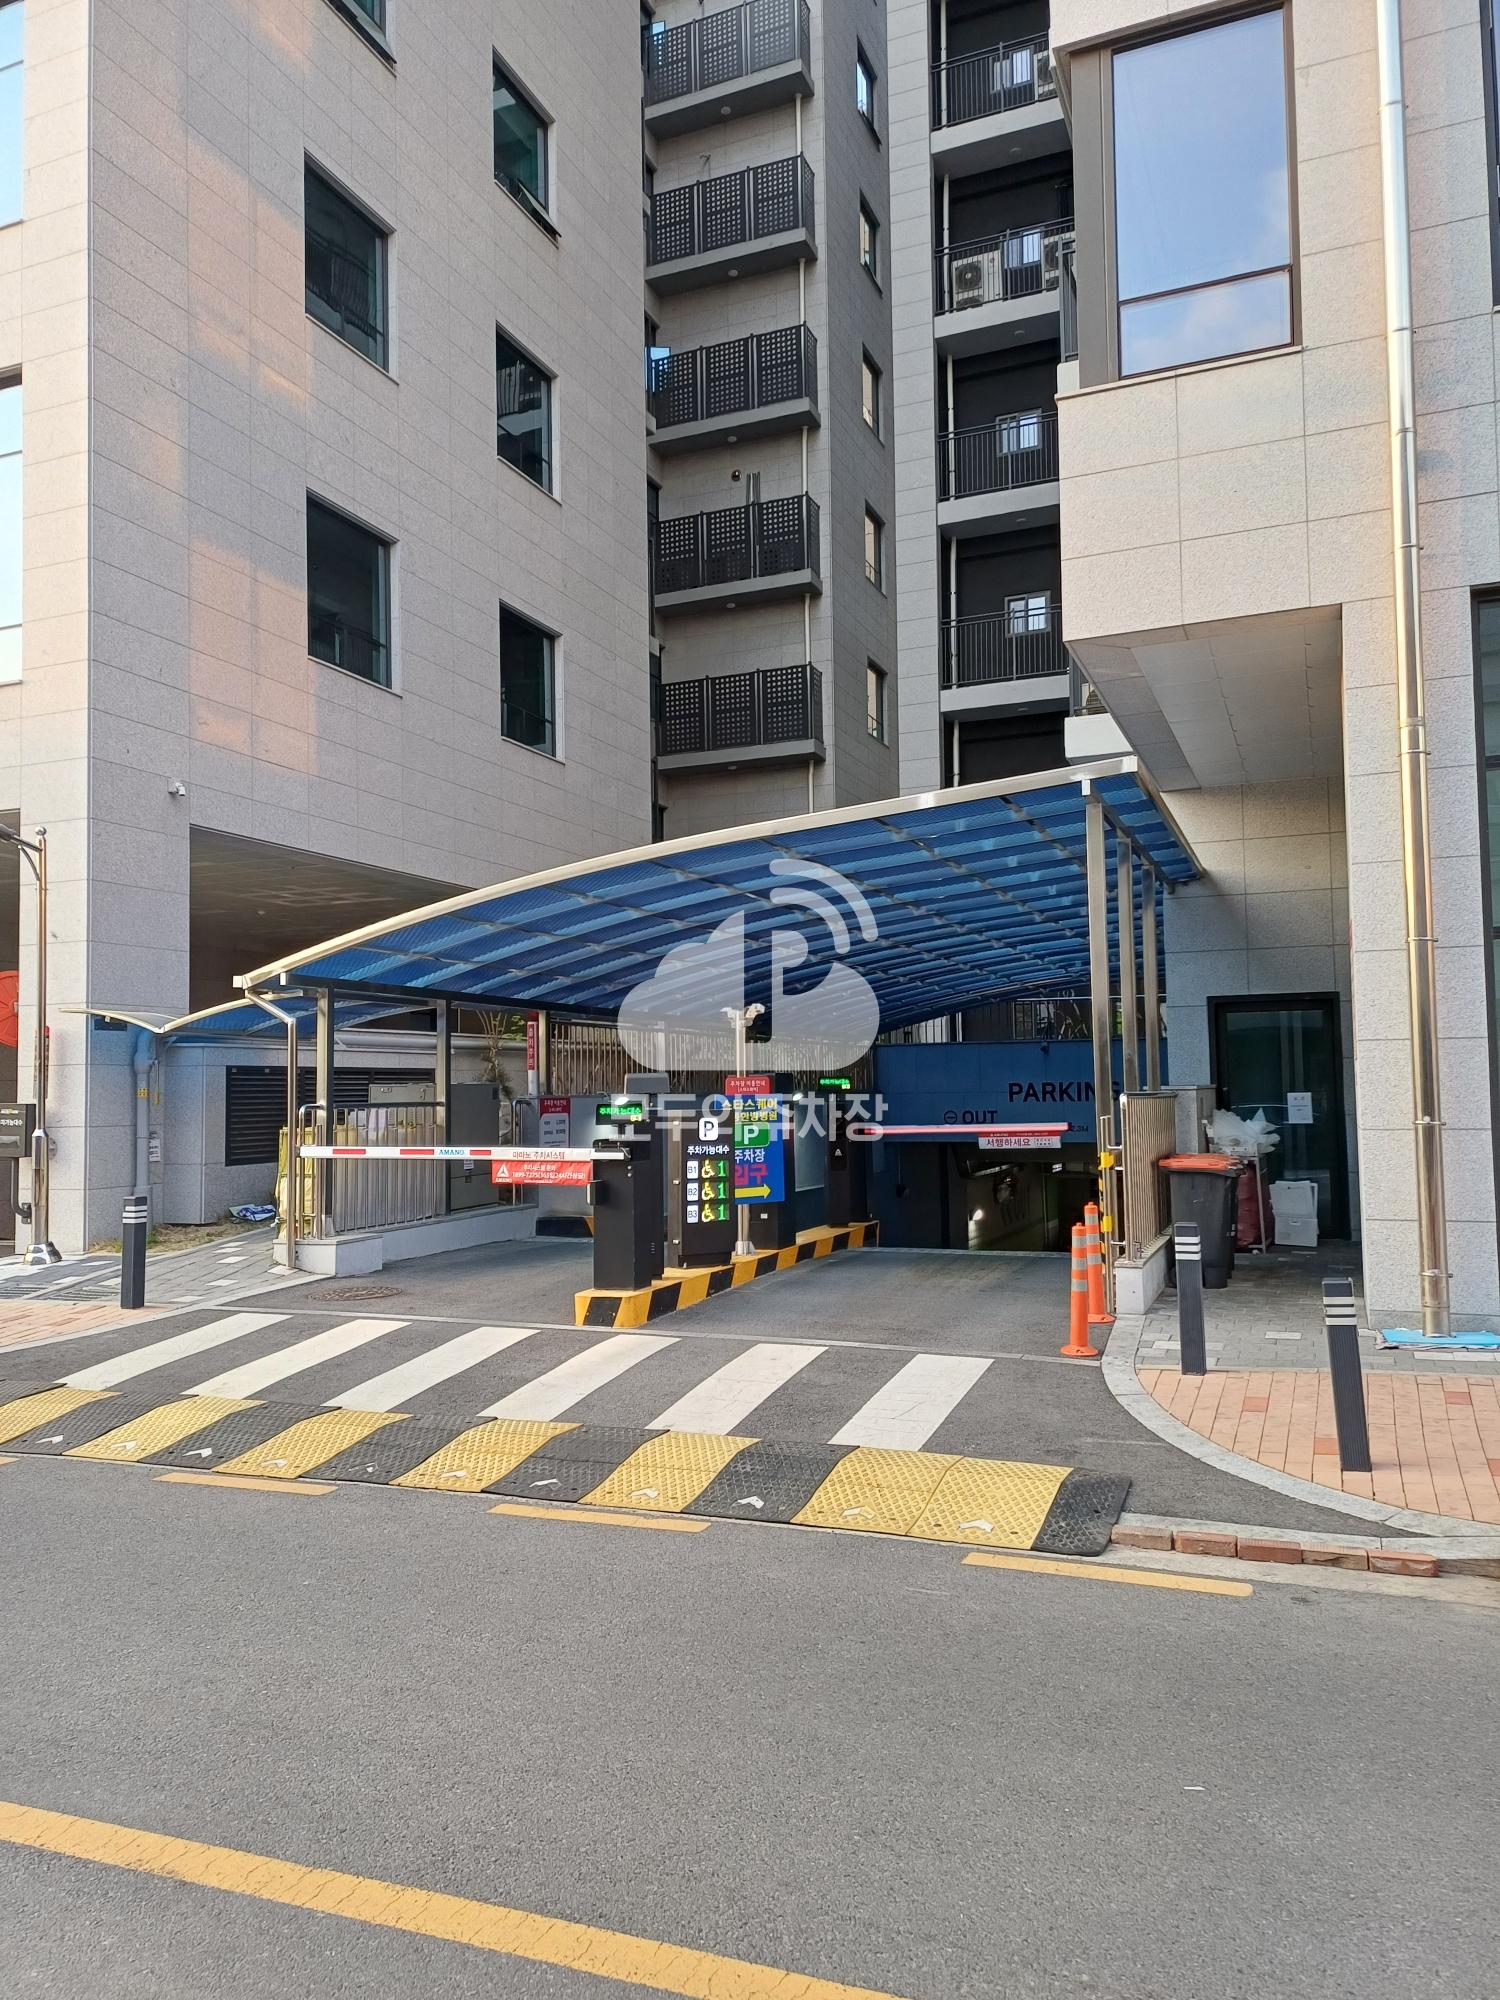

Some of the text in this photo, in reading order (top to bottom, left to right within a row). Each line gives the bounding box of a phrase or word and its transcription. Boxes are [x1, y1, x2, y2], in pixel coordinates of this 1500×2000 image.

[962, 1110, 998, 1124] OUT
[704, 1121, 715, 1138] P
[743, 1124, 760, 1145] P
[986, 1138, 1031, 1148] 서행하세요
[687, 1145, 730, 1155] 주차가능대수
[735, 1148, 766, 1163] 주차장
[688, 1187, 697, 1196] B2
[688, 1210, 697, 1218] B3
